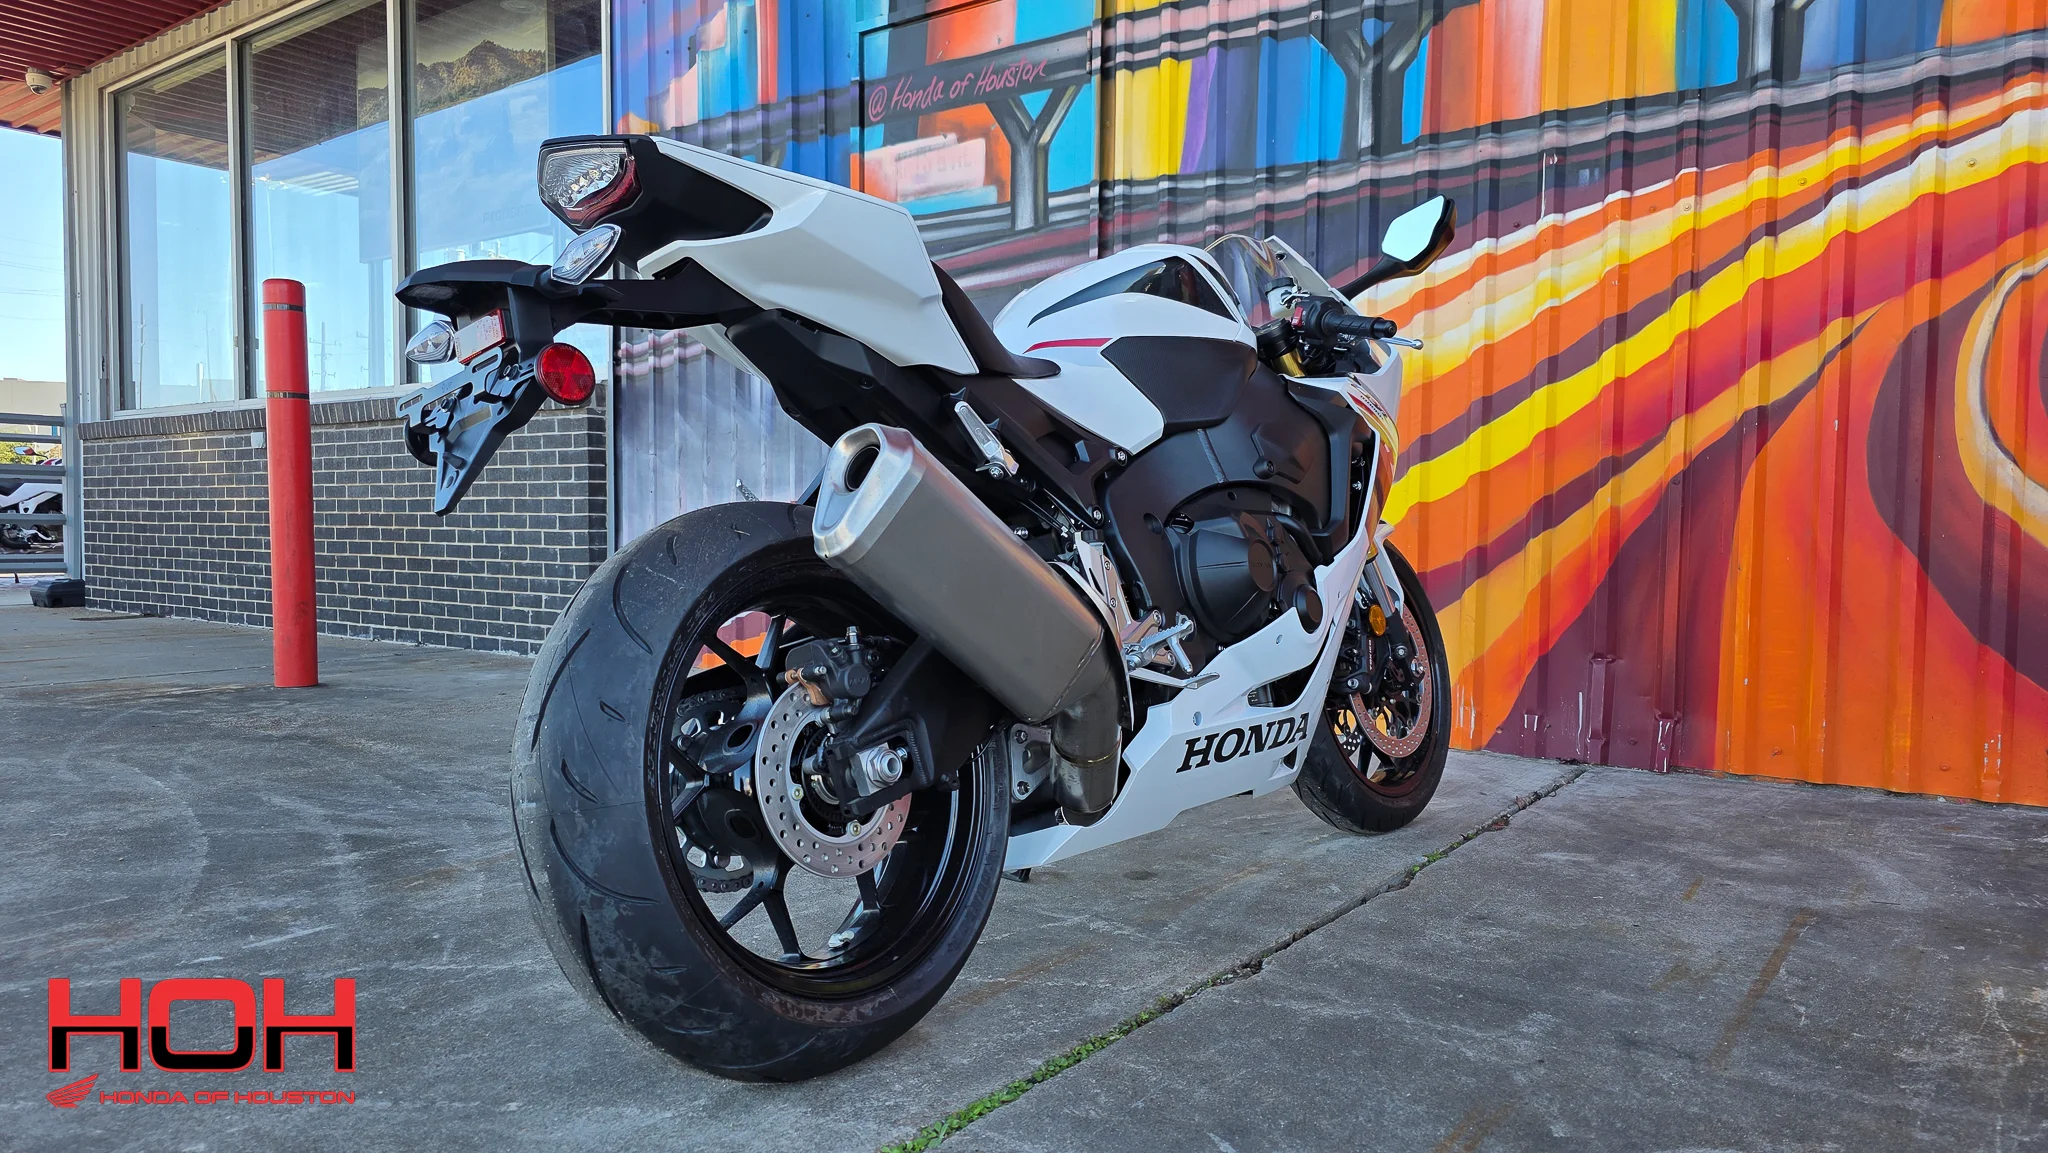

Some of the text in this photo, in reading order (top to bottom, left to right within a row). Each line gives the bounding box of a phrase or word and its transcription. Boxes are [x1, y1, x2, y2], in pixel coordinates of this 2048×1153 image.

[868, 55, 1048, 122] @ Honda of Houston
[1175, 712, 1310, 774] HONDA
